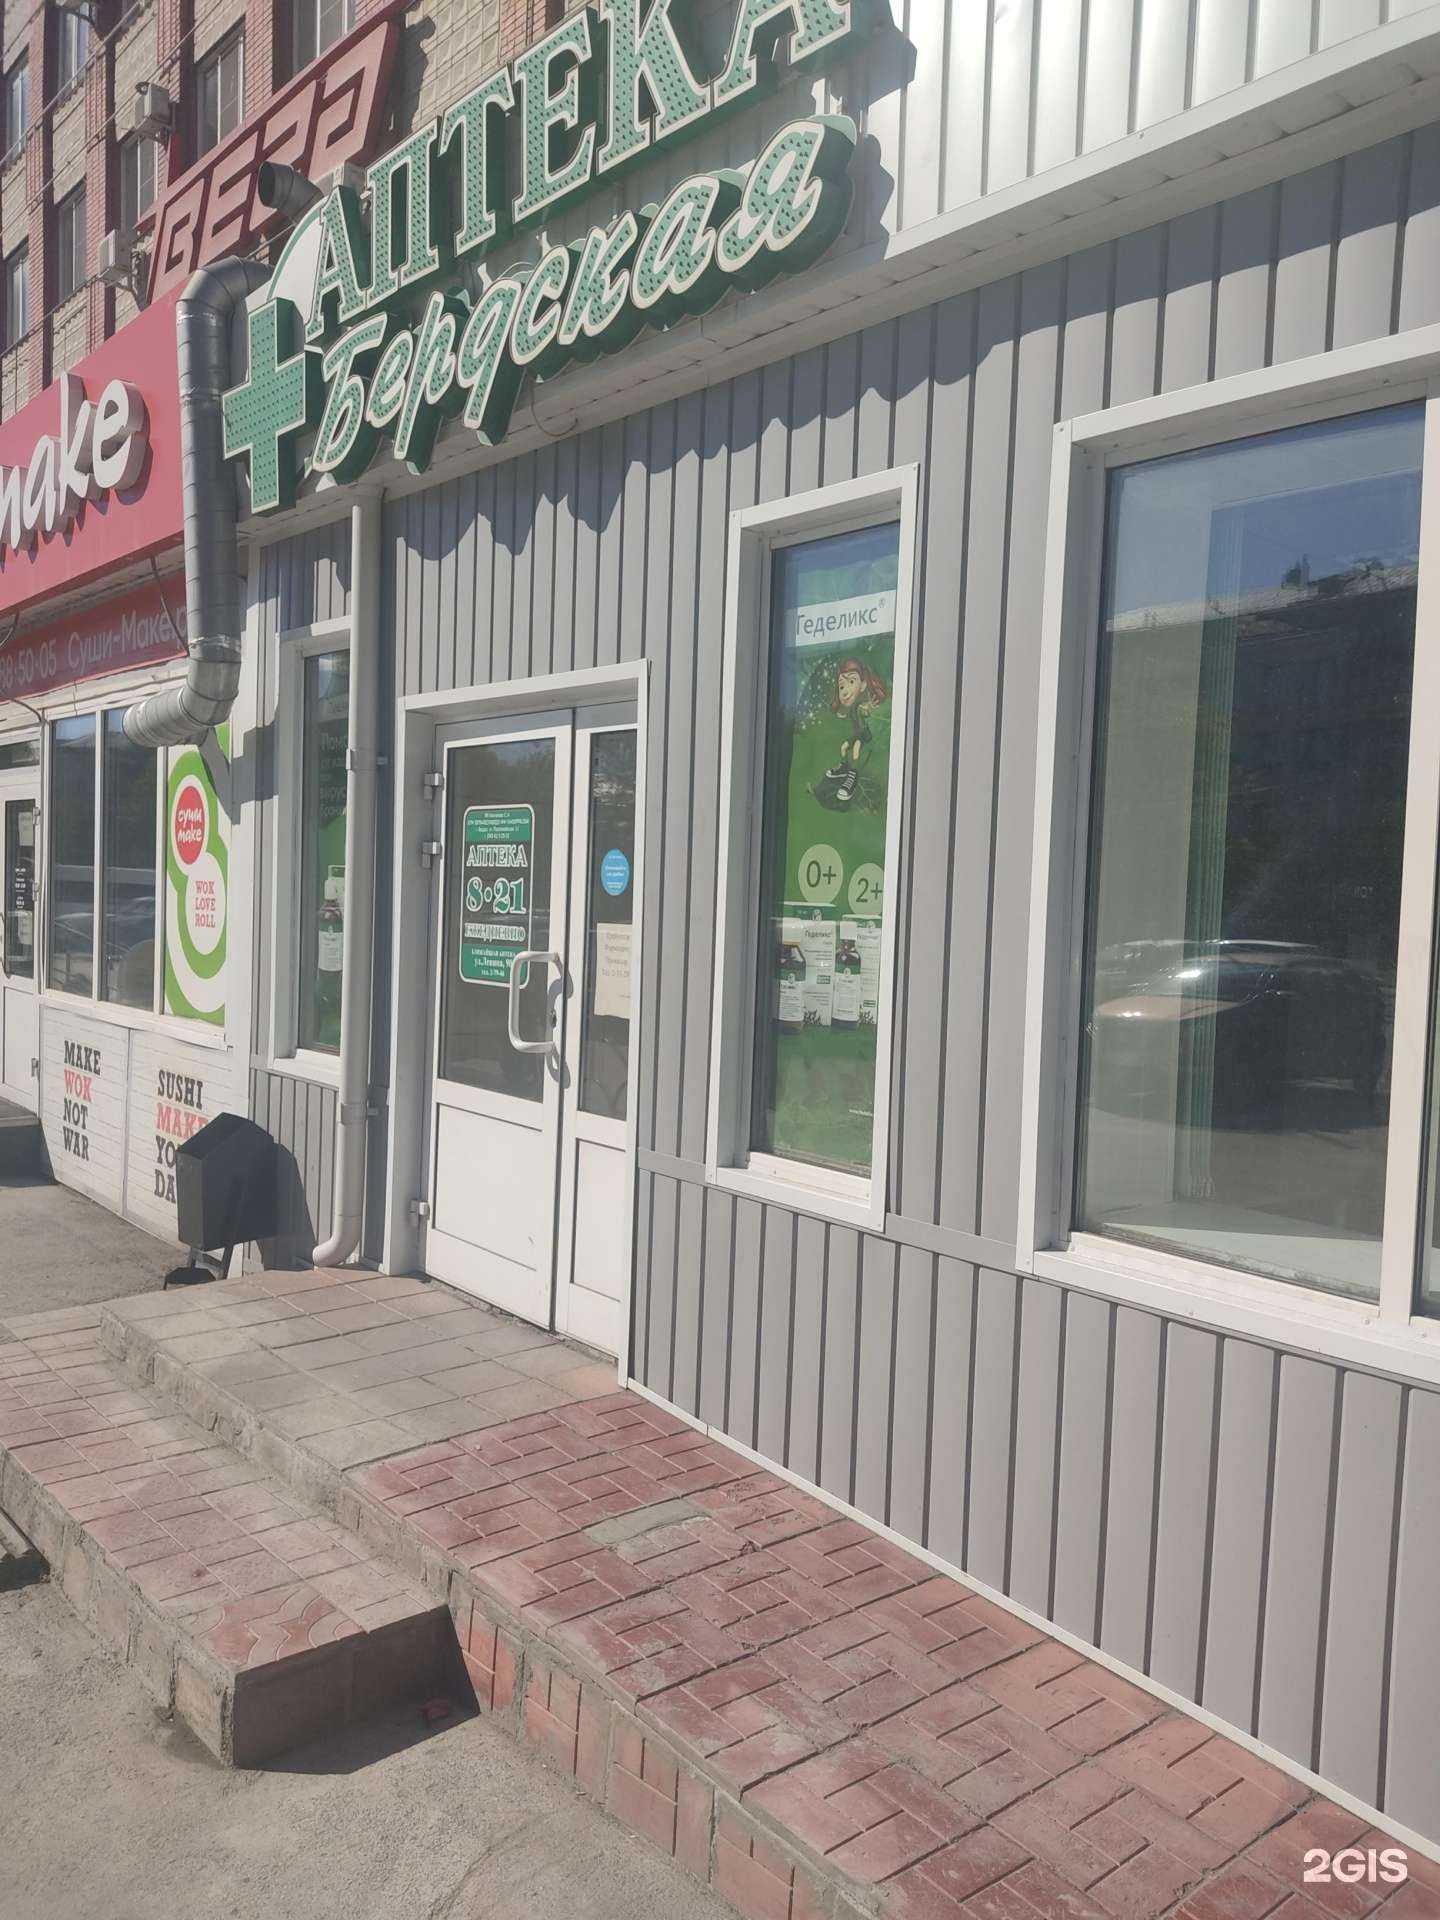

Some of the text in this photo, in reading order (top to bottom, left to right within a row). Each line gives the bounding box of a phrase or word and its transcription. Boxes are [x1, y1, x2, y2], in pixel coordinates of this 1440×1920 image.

[311, 118, 824, 472] Бердская
[177, 823, 202, 844] make
[466, 844, 528, 868] АПТЕКА
[195, 881, 215, 895] WOK
[806, 860, 837, 888] 0+
[855, 877, 882, 903] 2+
[195, 897, 216, 912] LOVE
[195, 913, 216, 929] ROLL
[64, 1040, 101, 1075] MAKE
[64, 1068, 92, 1103] WOK
[157, 1069, 204, 1111] SUSHI
[63, 1098, 88, 1130] NOT
[63, 1126, 89, 1161] WAR
